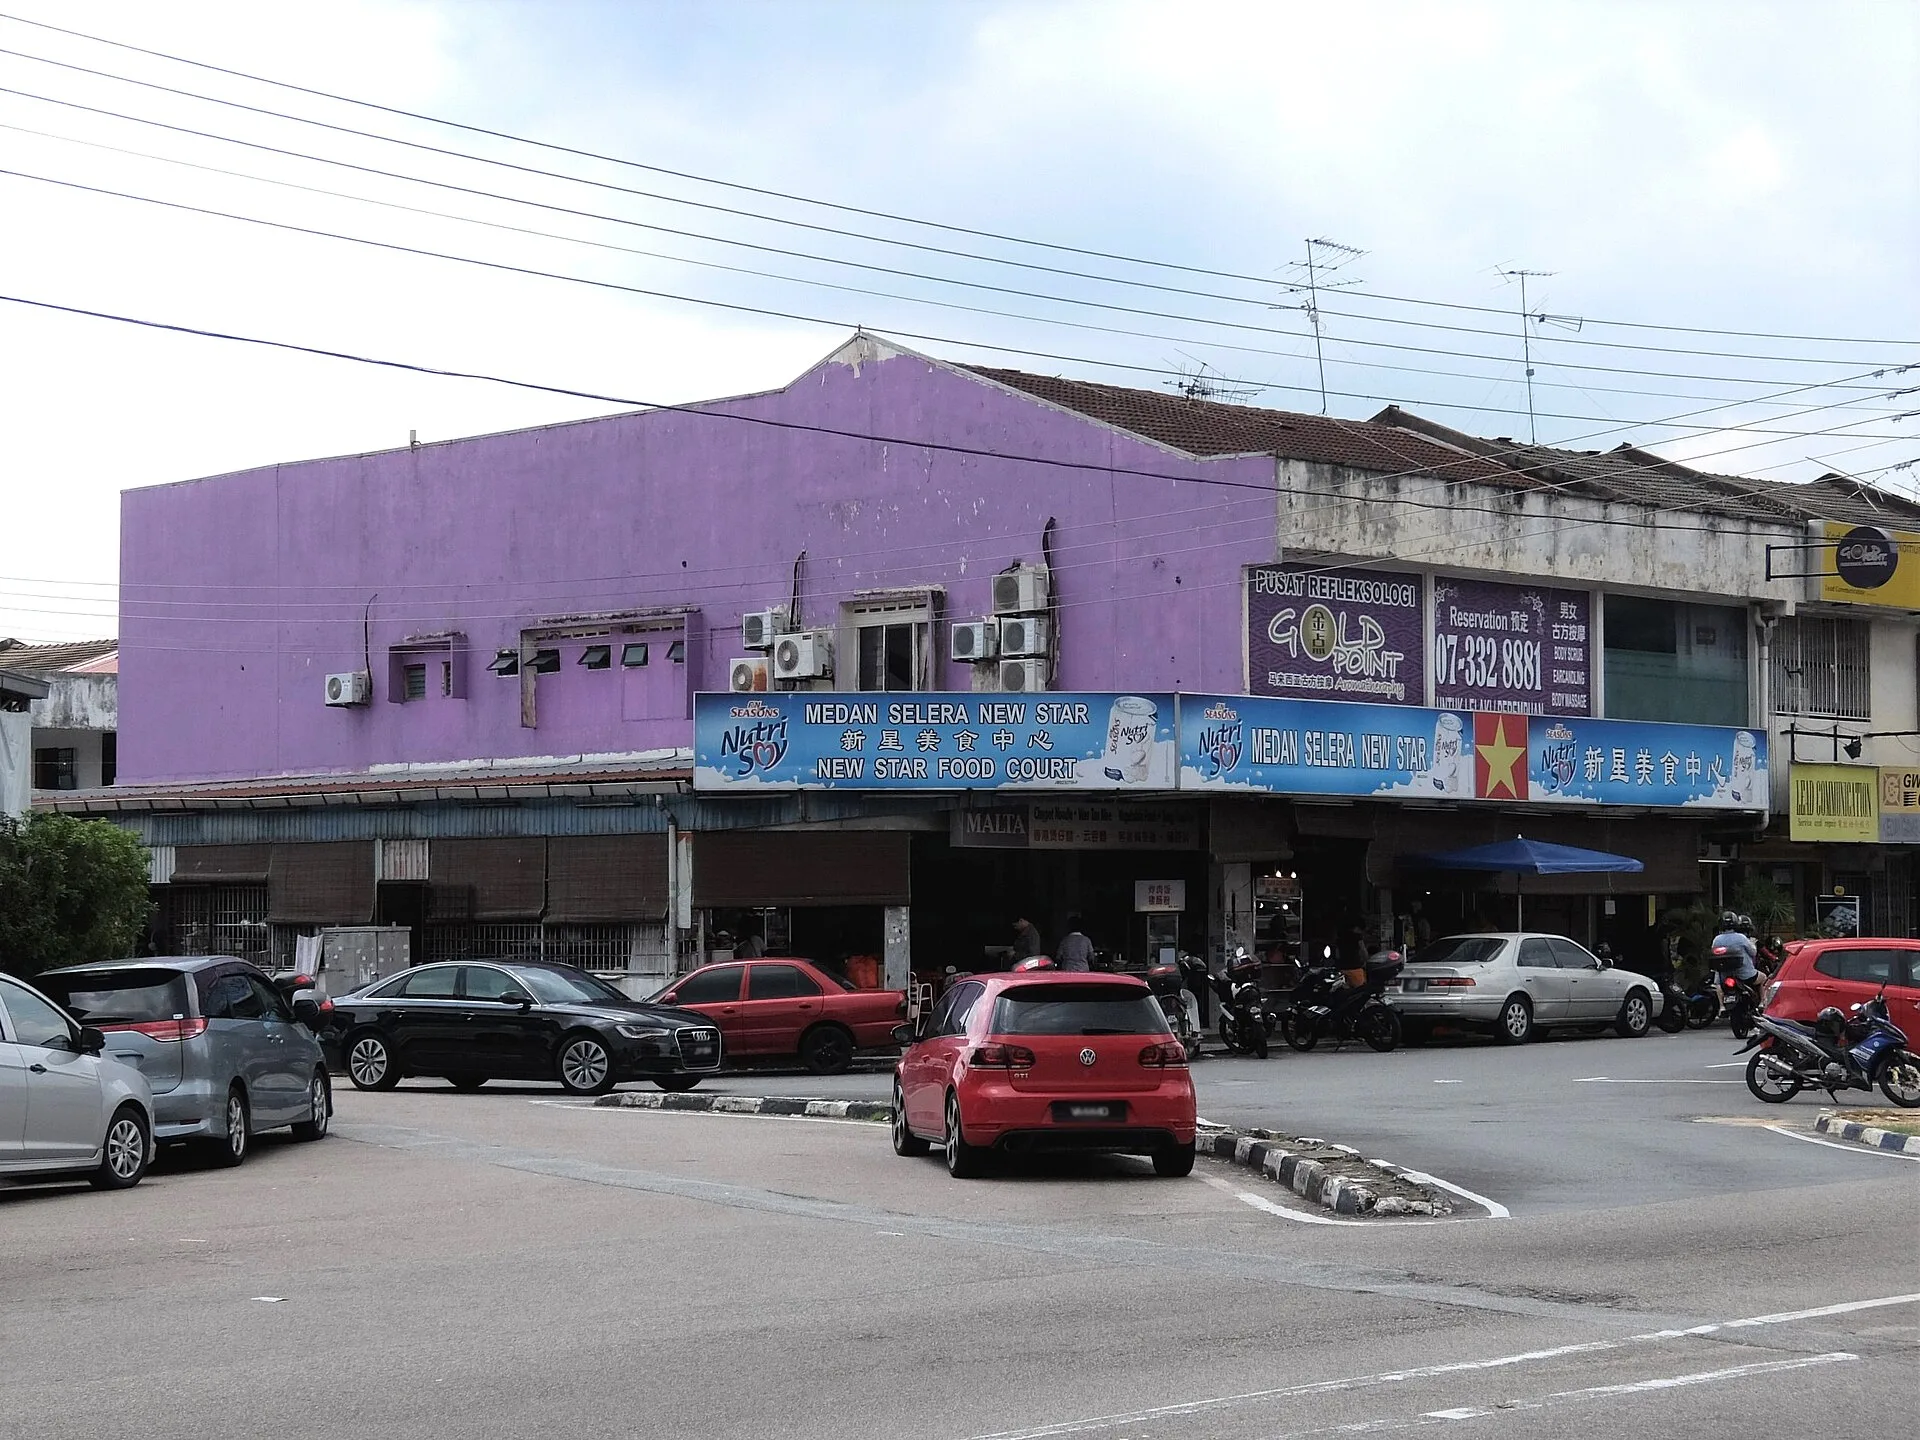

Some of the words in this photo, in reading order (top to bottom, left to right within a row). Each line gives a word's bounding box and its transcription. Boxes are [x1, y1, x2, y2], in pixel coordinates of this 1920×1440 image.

[1255, 570, 1305, 596] PUSAT
[1308, 575, 1417, 608] REFLEKSOLOGI
[1450, 605, 1508, 631] Reservation
[1560, 601, 1577, 620] 男女
[1268, 603, 1386, 662] GOLD
[1552, 622, 1586, 642] 古方按摩
[1332, 646, 1405, 681] POINT
[1436, 633, 1498, 688] 07-332
[1502, 638, 1542, 691] 8881
[730, 706, 780, 718] SEASONS
[805, 703, 878, 725] MEDAN
[888, 703, 970, 725] SELERA
[979, 703, 1026, 725] NEW
[1034, 703, 1089, 725] STAR
[1204, 708, 1237, 720] SEASONS
[721, 715, 788, 757] Nutri
[840, 729, 1054, 752] 新星美食中心
[1199, 718, 1242, 757] Nutri
[1546, 729, 1572, 739] SEASONS
[1250, 727, 1299, 766] MEDAN
[1304, 730, 1356, 769] SELERA
[1361, 733, 1392, 770] NEW
[1396, 736, 1428, 772] STAR
[1541, 738, 1577, 773] Nutri
[817, 757, 865, 780] NEW
[874, 757, 929, 780] STAR
[937, 757, 996, 780] FOOD
[1005, 757, 1078, 780] COURT
[1583, 745, 1727, 788] 新星美食中心
[1796, 780, 1815, 816] LEAD
[965, 811, 1027, 835] MALTA
